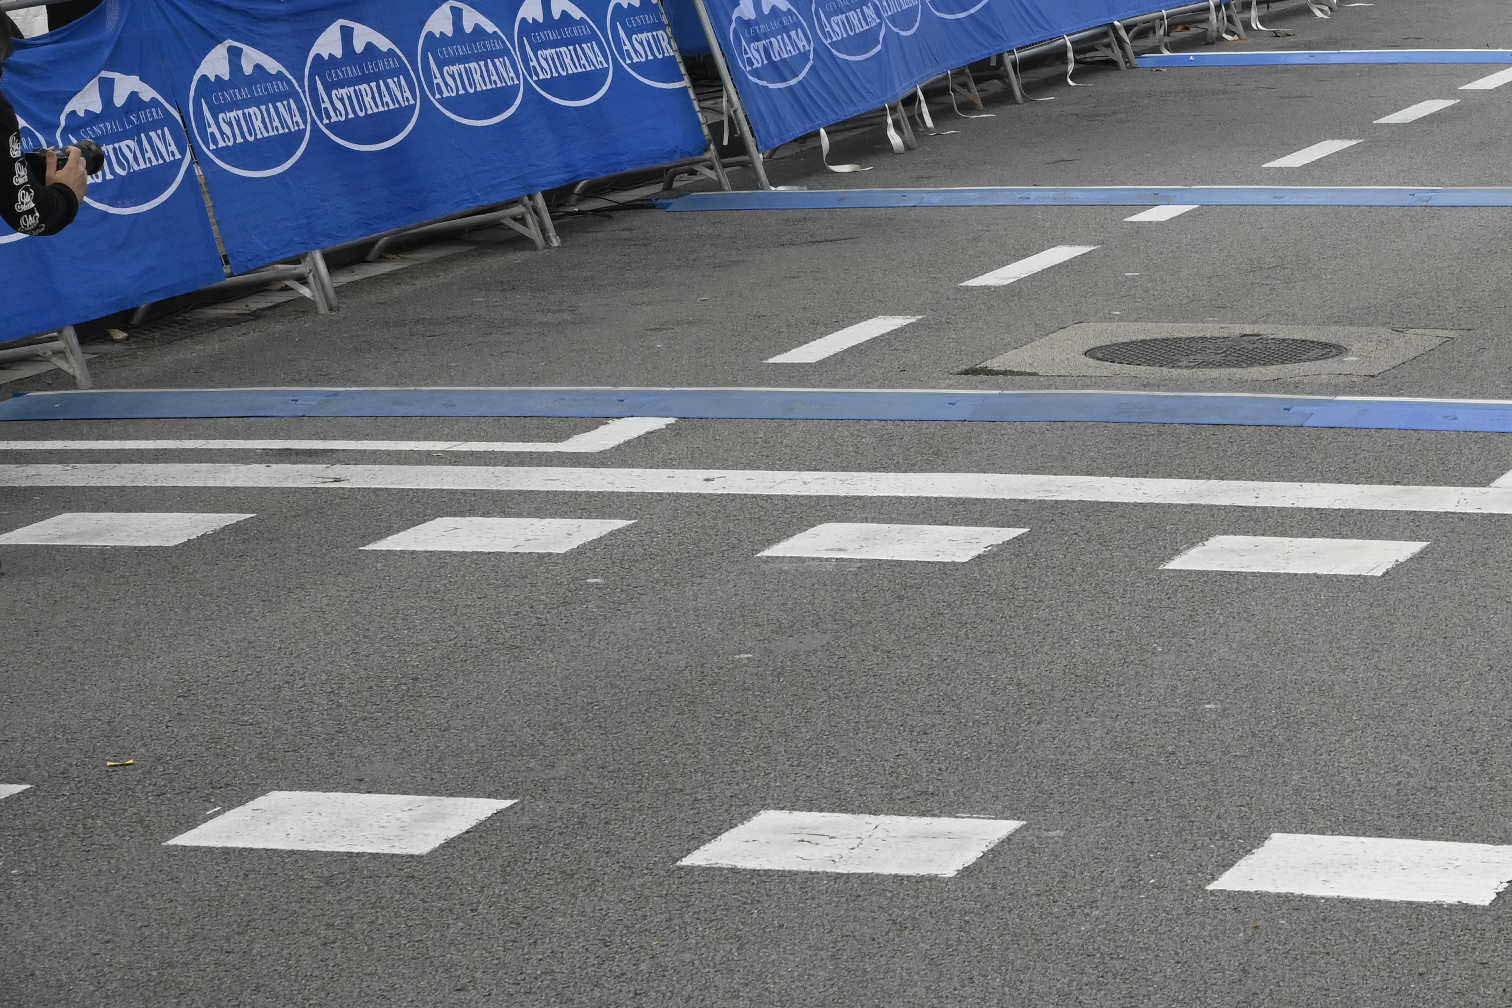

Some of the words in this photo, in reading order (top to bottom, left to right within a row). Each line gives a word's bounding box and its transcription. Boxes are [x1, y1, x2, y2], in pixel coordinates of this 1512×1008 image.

[531, 28, 560, 43] CENTRAL
[560, 24, 592, 39] LECHERA
[626, 14, 659, 28] CENTRAL
[437, 44, 472, 58] CENTRAL
[472, 39, 504, 53] LECHERA
[523, 36, 608, 81] ASTURIANA
[325, 64, 362, 82] CENTRAL
[364, 56, 400, 74] LECHERA
[427, 51, 519, 99] ASTURIANA
[212, 88, 251, 105] CENTRAL
[252, 80, 289, 98] LECHERA
[315, 74, 416, 124] ASTURIANA
[202, 97, 305, 150] ASTURIANA
